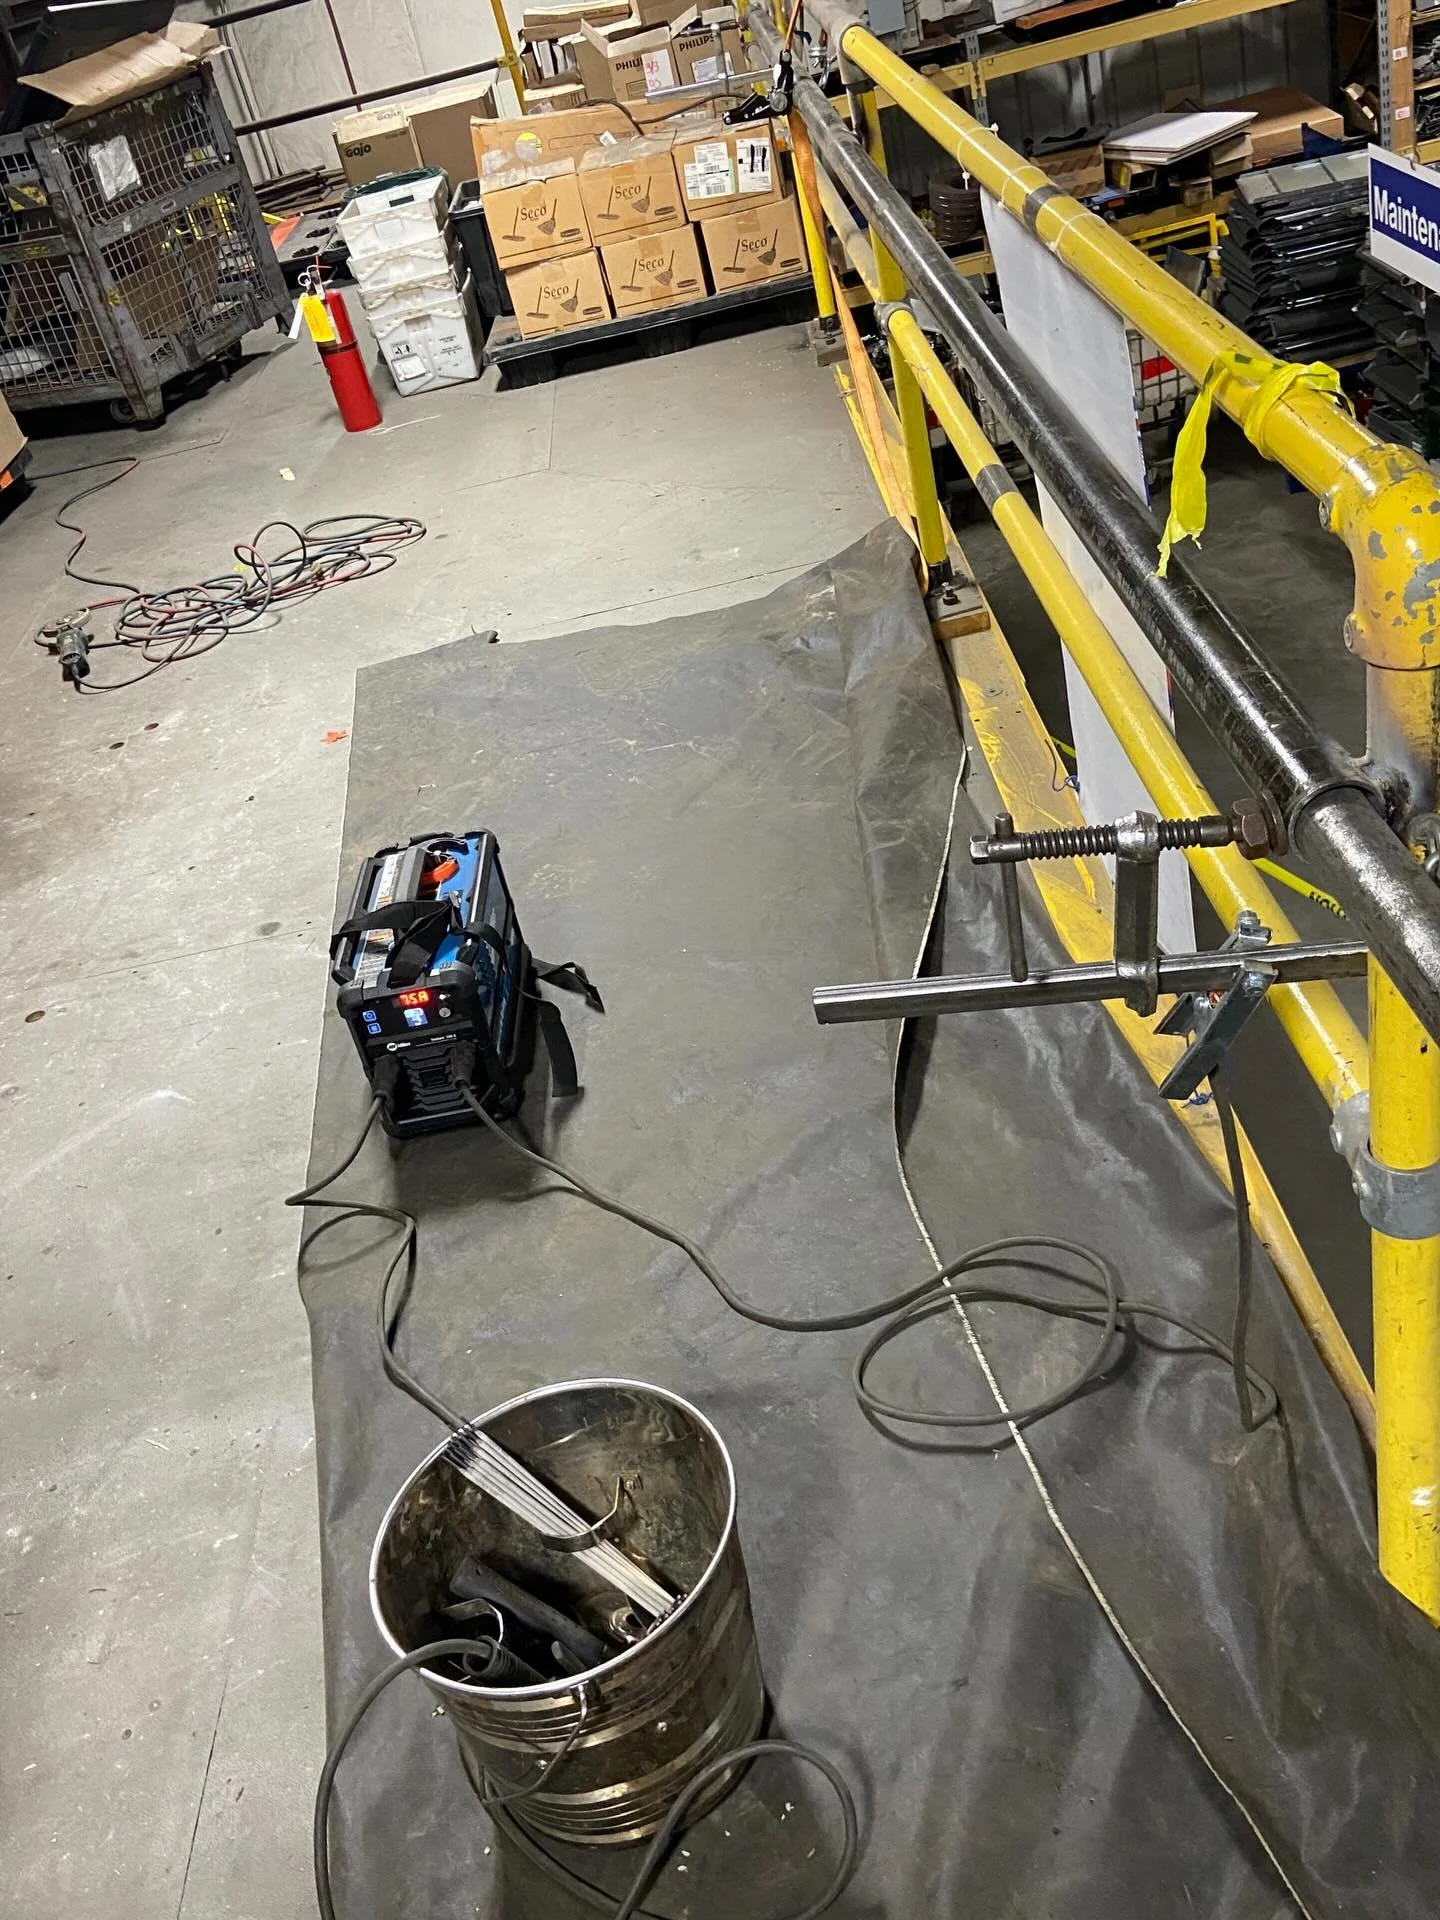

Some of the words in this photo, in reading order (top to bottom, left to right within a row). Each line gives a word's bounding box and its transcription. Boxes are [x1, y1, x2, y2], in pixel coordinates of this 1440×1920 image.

[616, 56, 643, 71] PHILI
[614, 185, 641, 199] Seco
[520, 205, 547, 220] Seco
[741, 237, 767, 252] Seco
[638, 258, 664, 272] Seco
[543, 285, 569, 299] Seco
